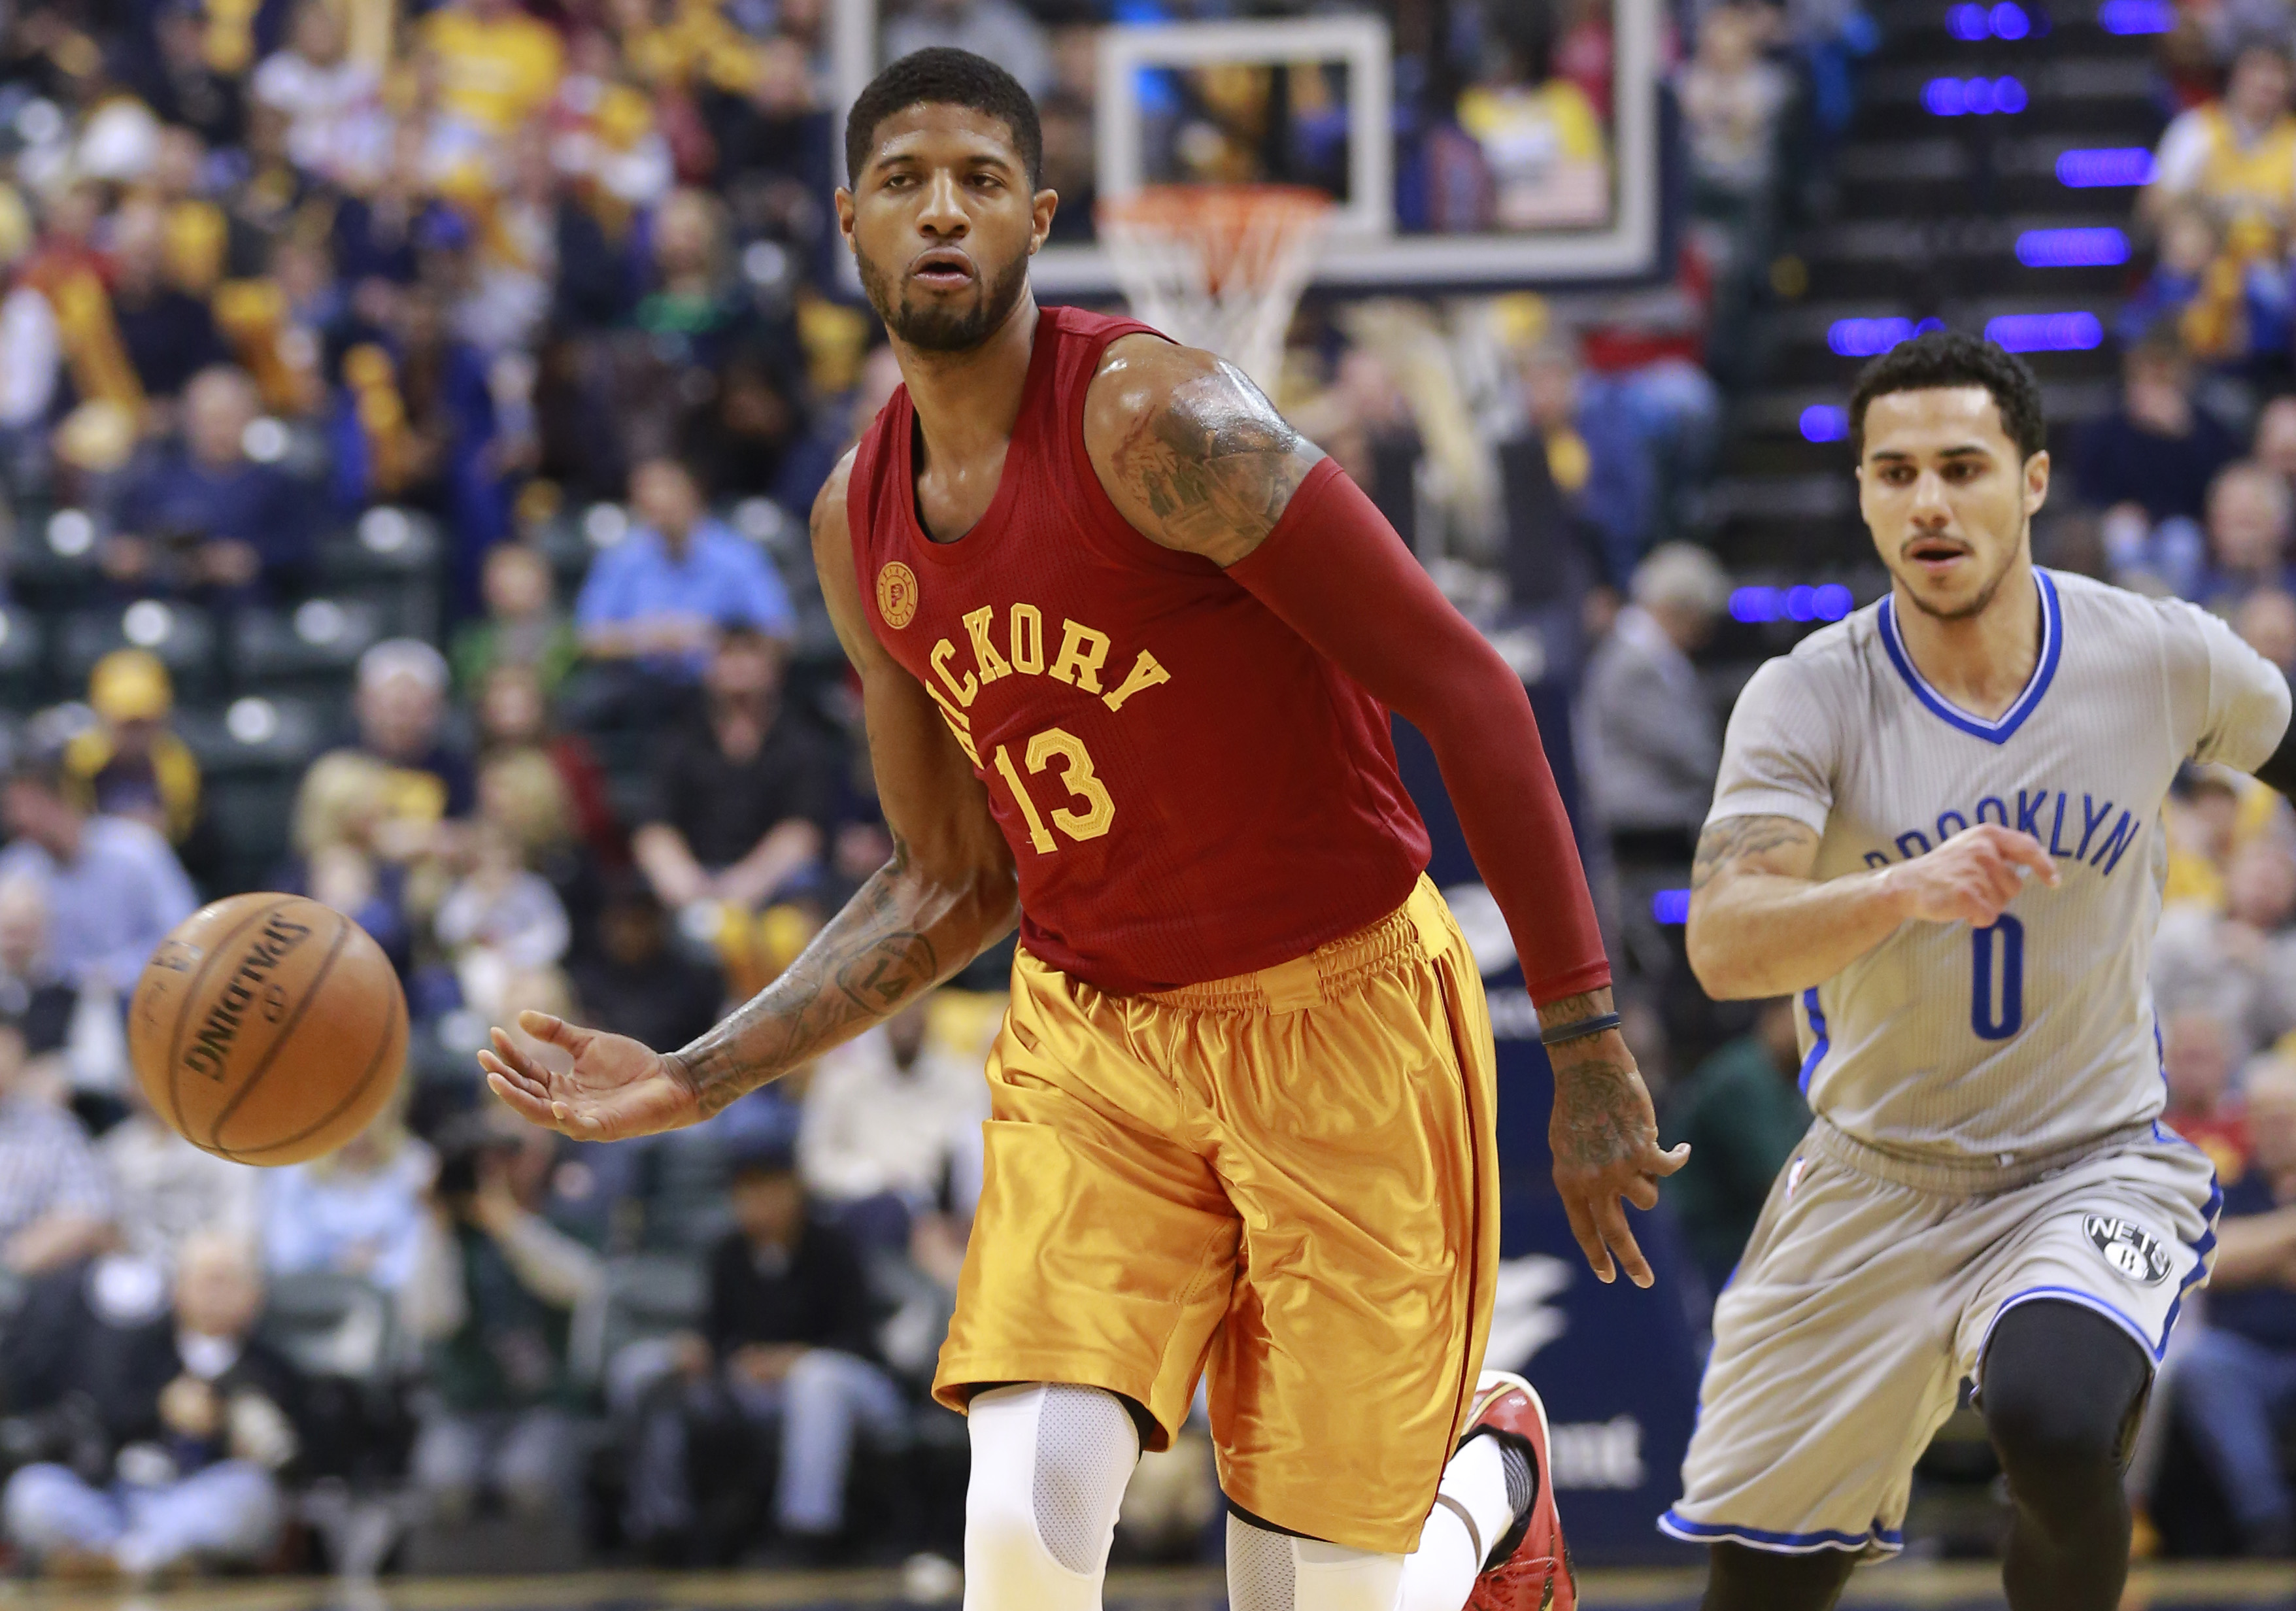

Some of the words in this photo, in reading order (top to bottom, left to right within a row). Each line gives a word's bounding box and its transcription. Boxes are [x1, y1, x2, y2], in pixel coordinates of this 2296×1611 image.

[994, 727, 1116, 855] 13
[1863, 789, 2140, 876] KLYN
[184, 913, 312, 1082] SPALDING
[1970, 913, 2024, 1041] 0
[2090, 1217, 2170, 1276] NETS
